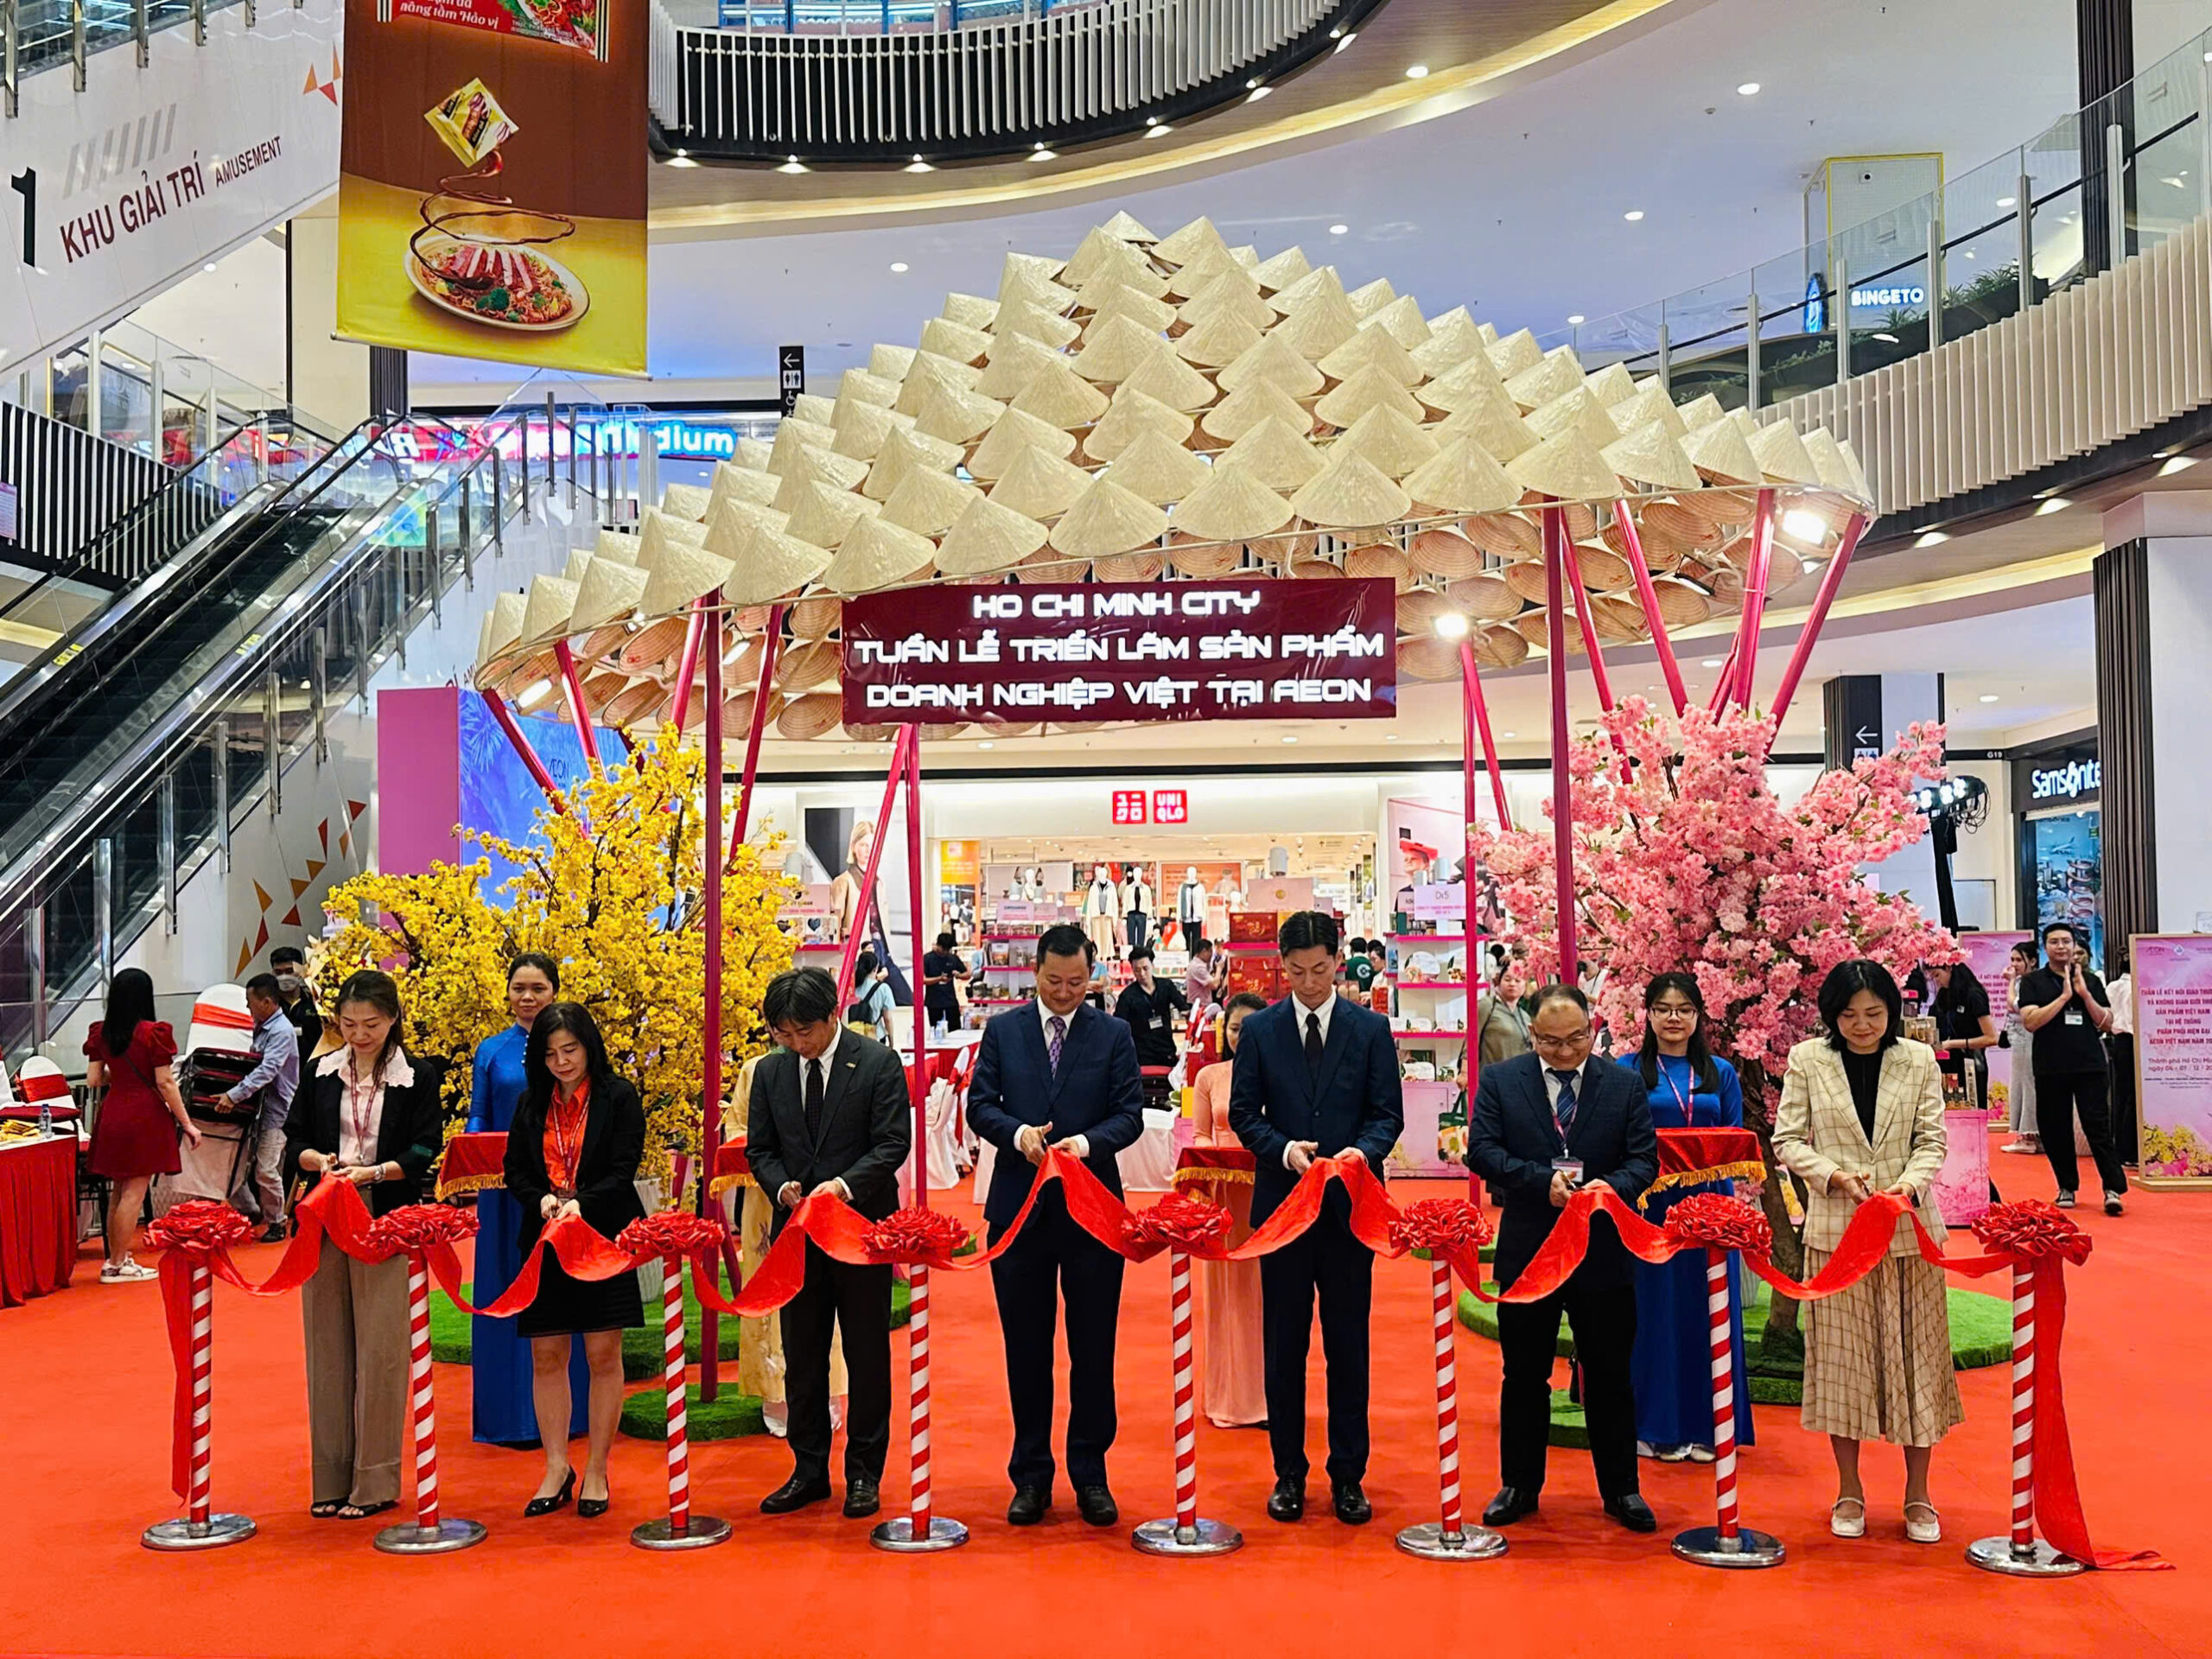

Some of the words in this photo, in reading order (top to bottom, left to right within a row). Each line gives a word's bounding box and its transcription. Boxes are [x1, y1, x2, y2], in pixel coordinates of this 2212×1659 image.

[11, 166, 35, 268] 1
[60, 205, 115, 263] KHU
[119, 169, 167, 233] GIẢI
[167, 150, 205, 207] TRÍ
[215, 136, 282, 188] AMUSEMENT
[1851, 288, 1924, 306] BINGETO
[973, 594, 1023, 619] HO
[1032, 593, 1085, 618] CHI
[1093, 592, 1173, 617] MINH
[1181, 589, 1261, 615] CITY
[854, 632, 950, 664] TUẦN
[958, 629, 1001, 663] LỄ
[1009, 629, 1109, 662] TRIỂN
[1117, 631, 1190, 660] LÃM
[1198, 629, 1272, 659] SẢN
[1281, 625, 1384, 659] PHẨM
[867, 683, 983, 708] DOANH
[993, 676, 1115, 710] NGHIỆP
[1123, 675, 1198, 709] VIỆT
[1207, 679, 1264, 707] TẠI
[1274, 678, 1371, 703] AEON
[2032, 760, 2101, 798] Samsonite
[1156, 792, 1183, 806] UNI
[1156, 806, 1185, 823] QLO
